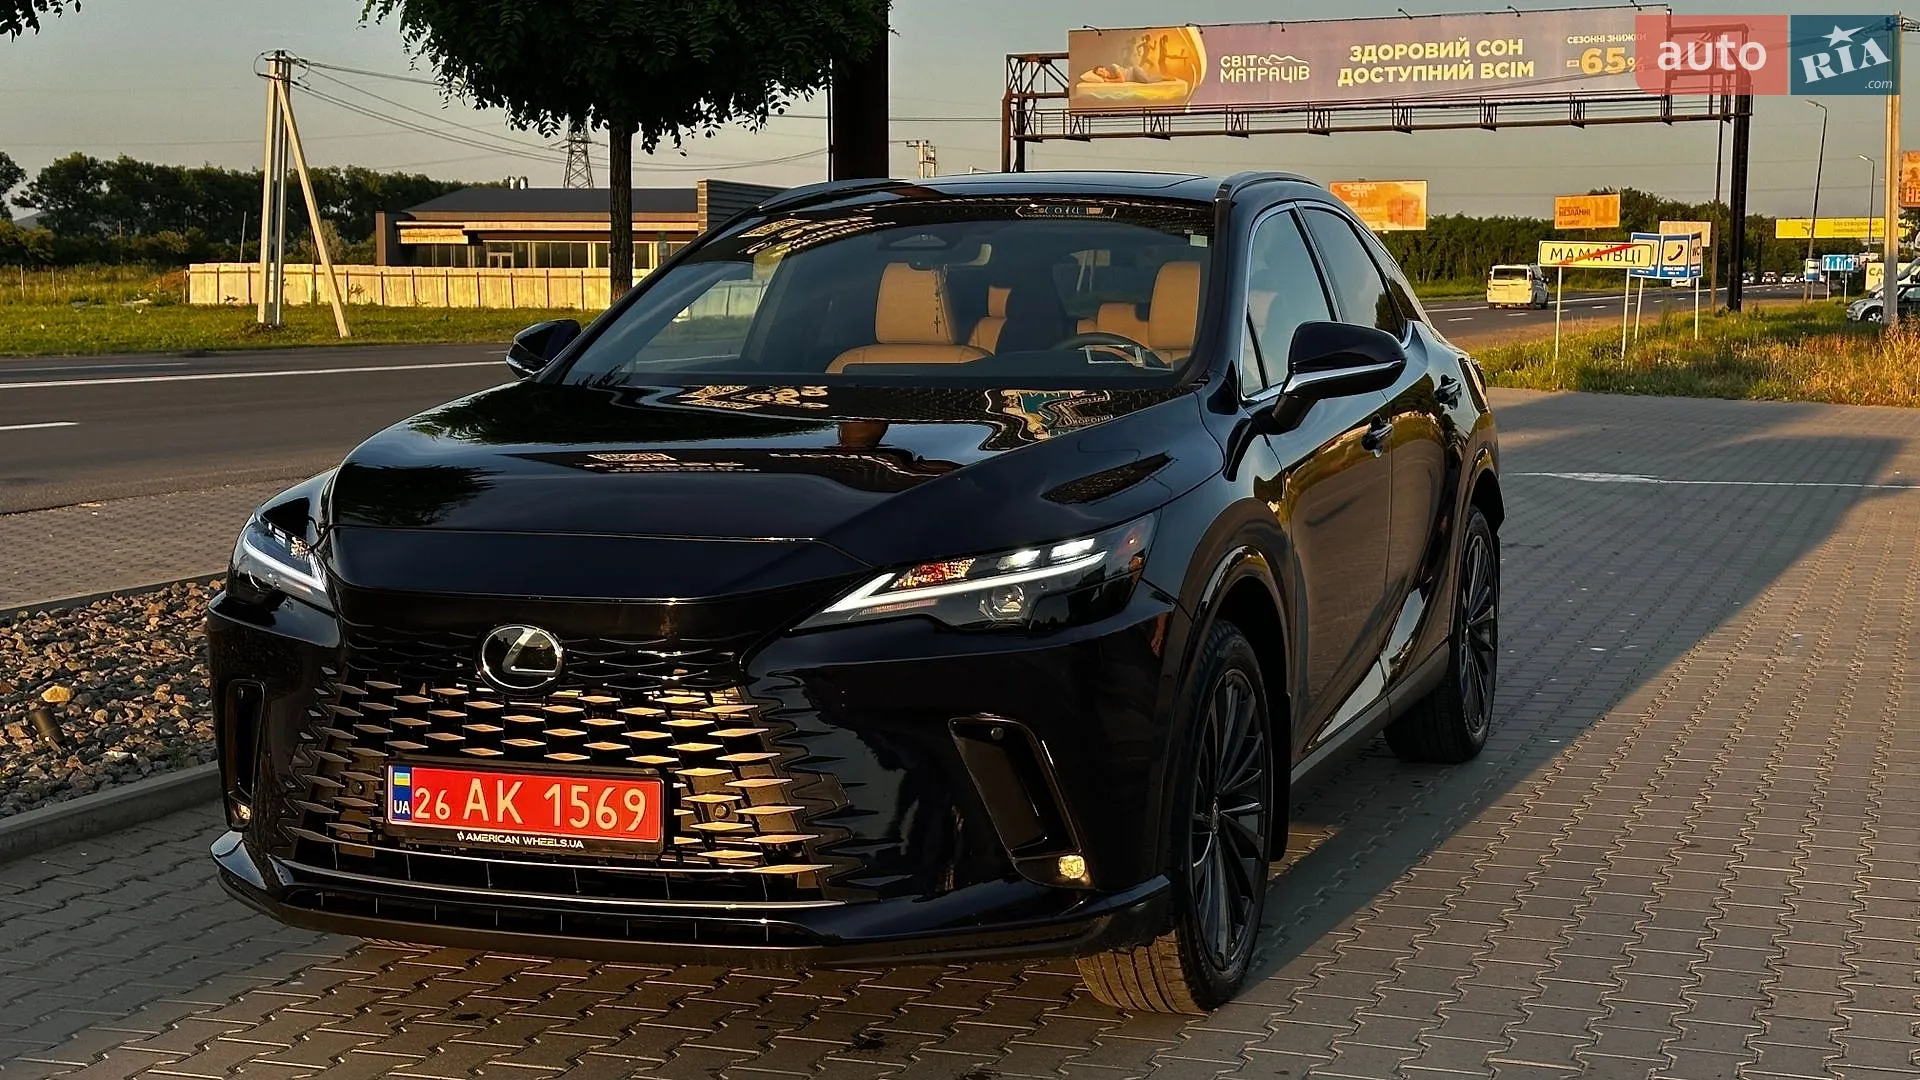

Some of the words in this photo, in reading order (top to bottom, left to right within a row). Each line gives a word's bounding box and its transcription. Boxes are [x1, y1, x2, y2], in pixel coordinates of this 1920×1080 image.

[1567, 33, 1605, 44] СЕЗОННІ
[1349, 37, 1471, 64] ЗДОРОВИЙ
[1476, 38, 1524, 56] СОН
[1220, 54, 1258, 68] СВІТ
[1220, 65, 1311, 84] МАТРАЦІВ
[1337, 61, 1474, 87] ДОСТУПНИЙ
[1480, 60, 1535, 80] ВСІМ
[1550, 244, 1641, 264] МАМАЇВЦІ
[393, 799, 410, 815] UA
[414, 787, 451, 820] 26
[463, 777, 524, 825] AK
[543, 783, 648, 832] 1569
[465, 832, 520, 845] AMERICAN
[522, 835, 584, 849] WHEELS.UA
